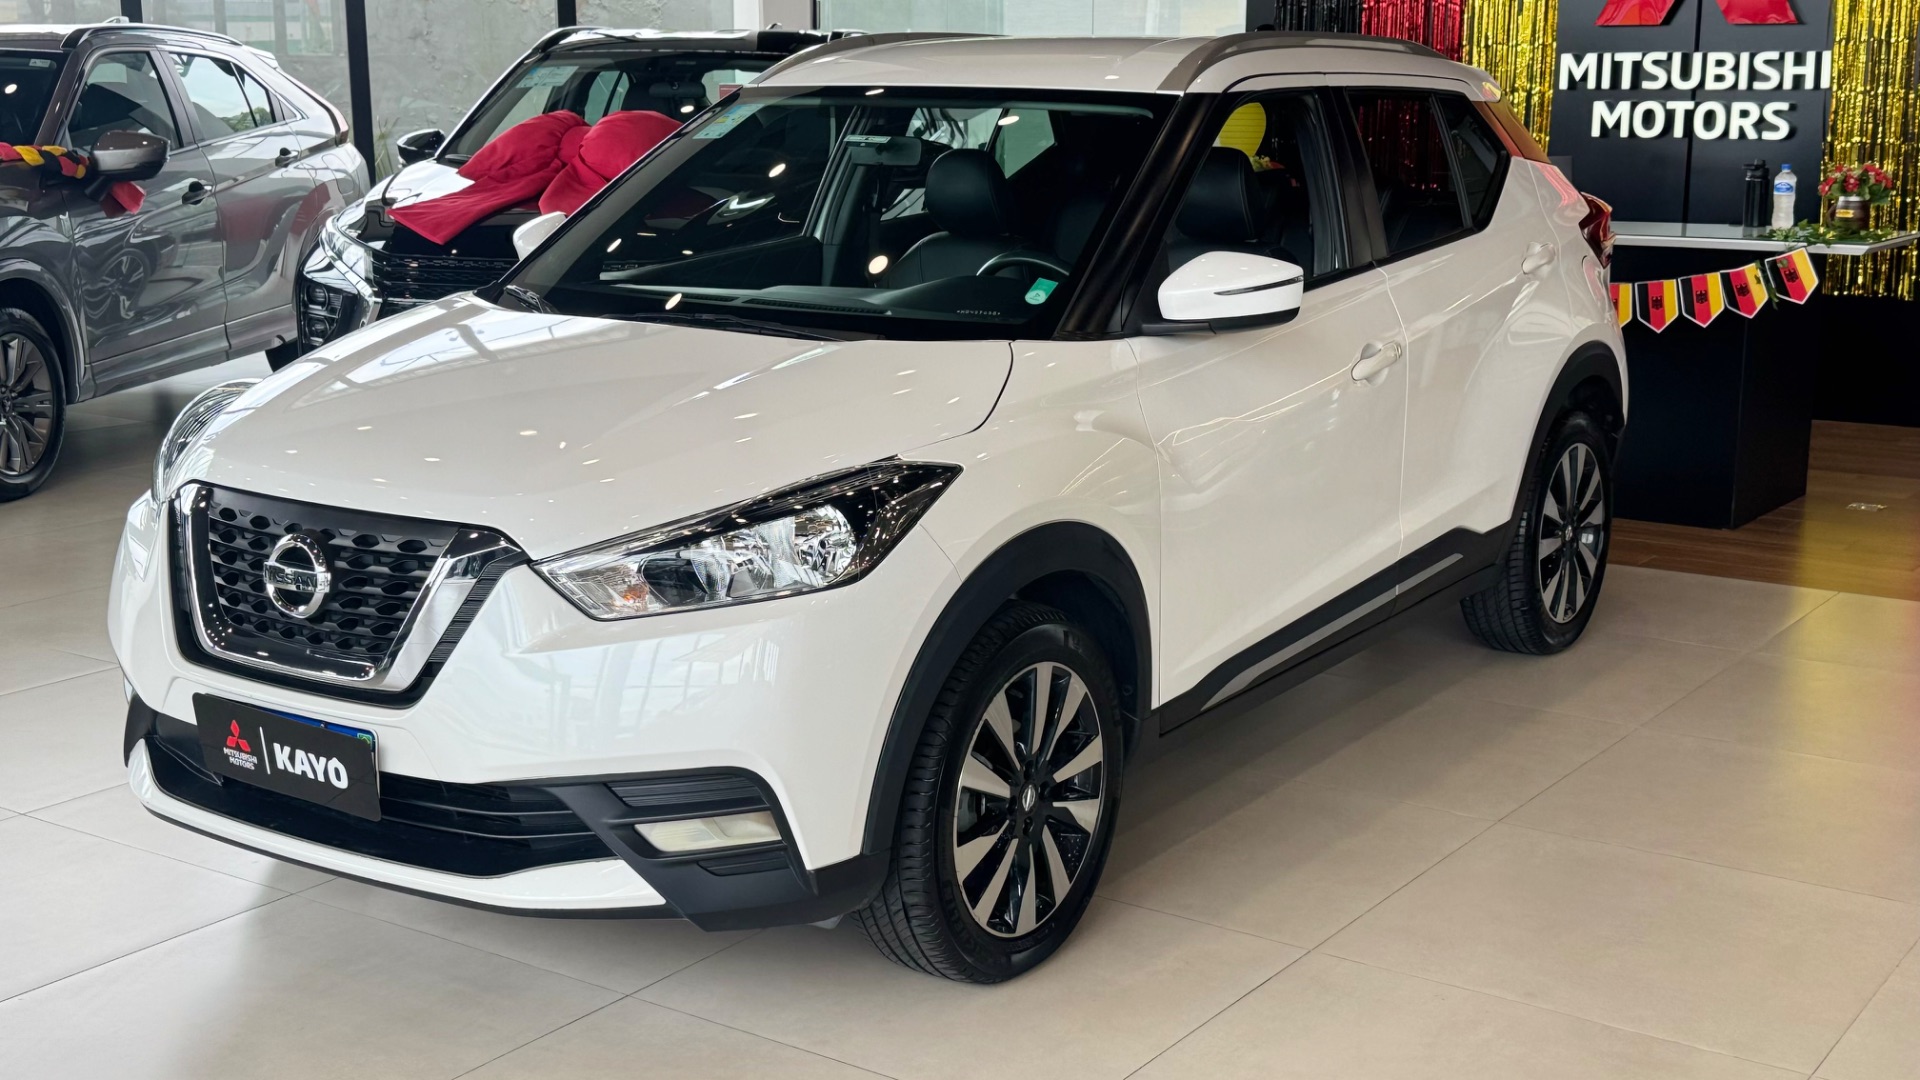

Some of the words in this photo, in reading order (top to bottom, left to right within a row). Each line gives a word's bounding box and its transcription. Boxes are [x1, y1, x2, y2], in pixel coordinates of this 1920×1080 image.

[1558, 50, 1832, 91] MITSUBISHI
[1591, 100, 1790, 140] MOTORS
[263, 562, 318, 592] NISSAN
[223, 746, 258, 765] MITSUBISHI
[229, 756, 255, 771] MOTORS
[273, 742, 349, 790] KAYO
